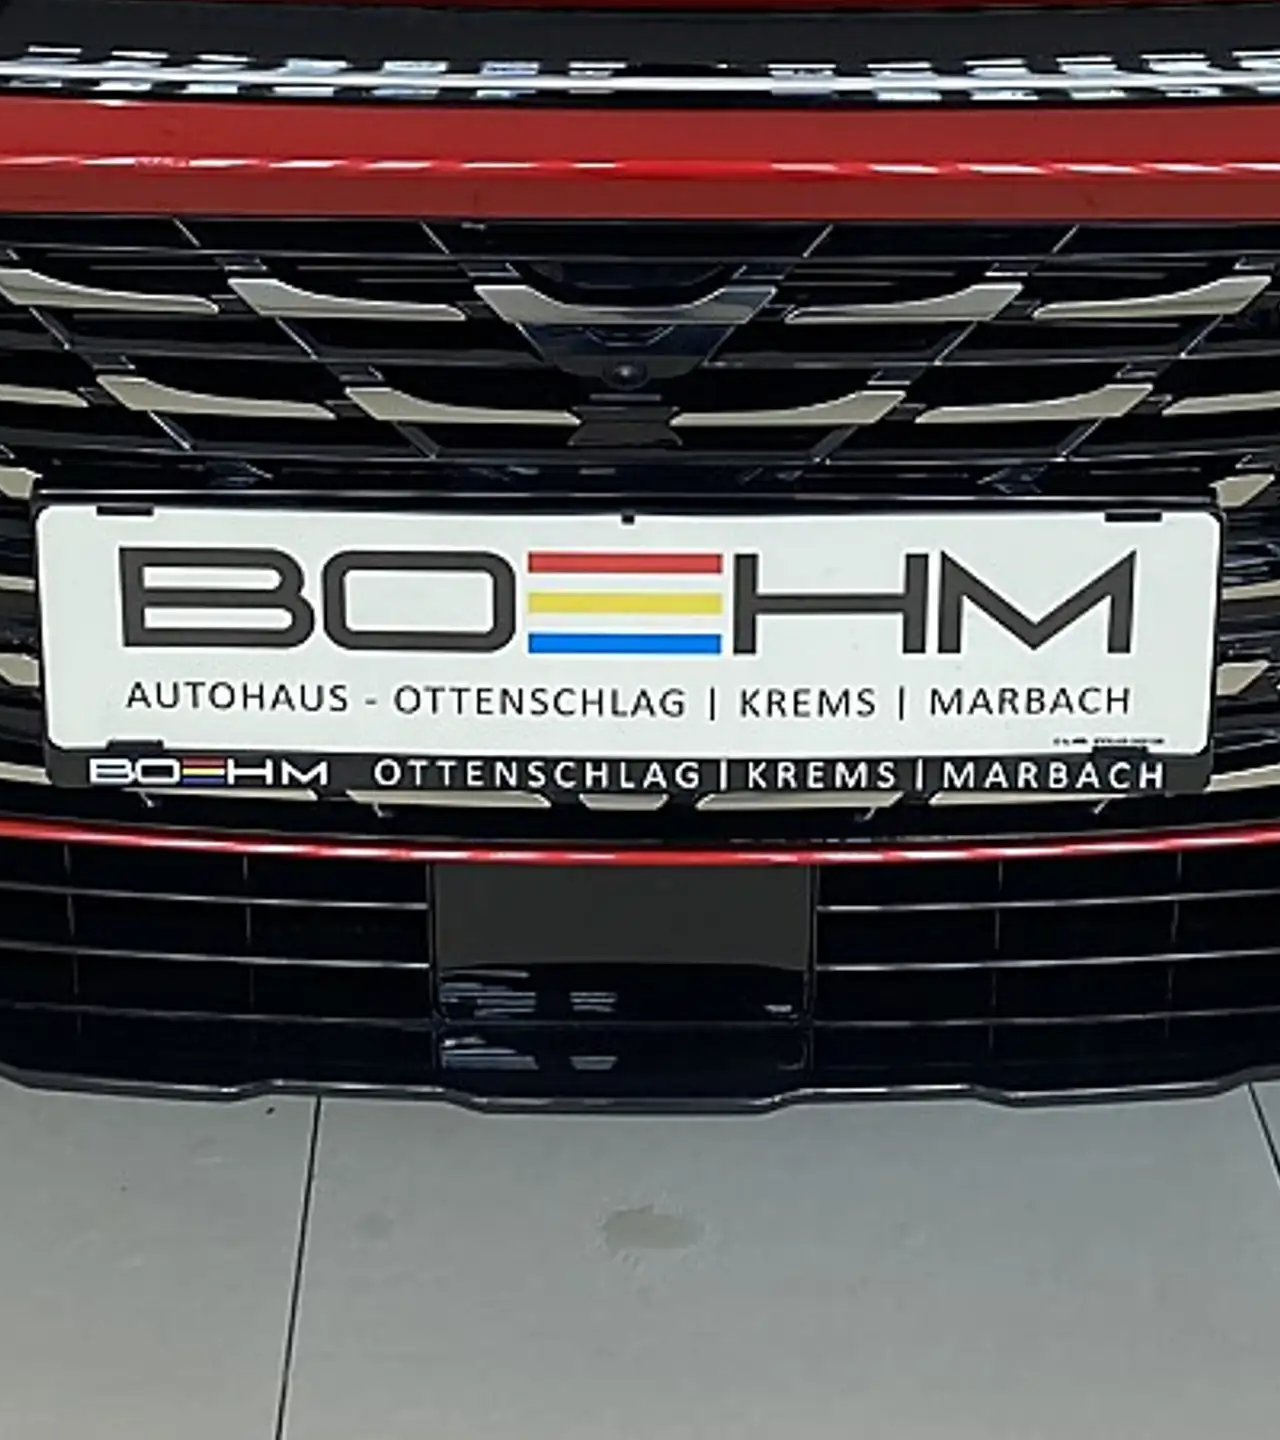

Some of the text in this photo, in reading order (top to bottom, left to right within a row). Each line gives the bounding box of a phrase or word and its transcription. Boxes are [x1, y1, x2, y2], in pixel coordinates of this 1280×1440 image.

[118, 546, 1137, 656] BOEHM
[125, 680, 348, 712] AUTOHAUS
[393, 684, 685, 717] OTTENSCHLAG
[740, 687, 876, 718] KREMS
[929, 686, 1131, 716] MARBACH
[88, 757, 329, 786] BOEHM
[373, 758, 700, 788] OTTENSCHLAG
[748, 760, 896, 789] KREMS
[942, 760, 1163, 789] MARBACH
